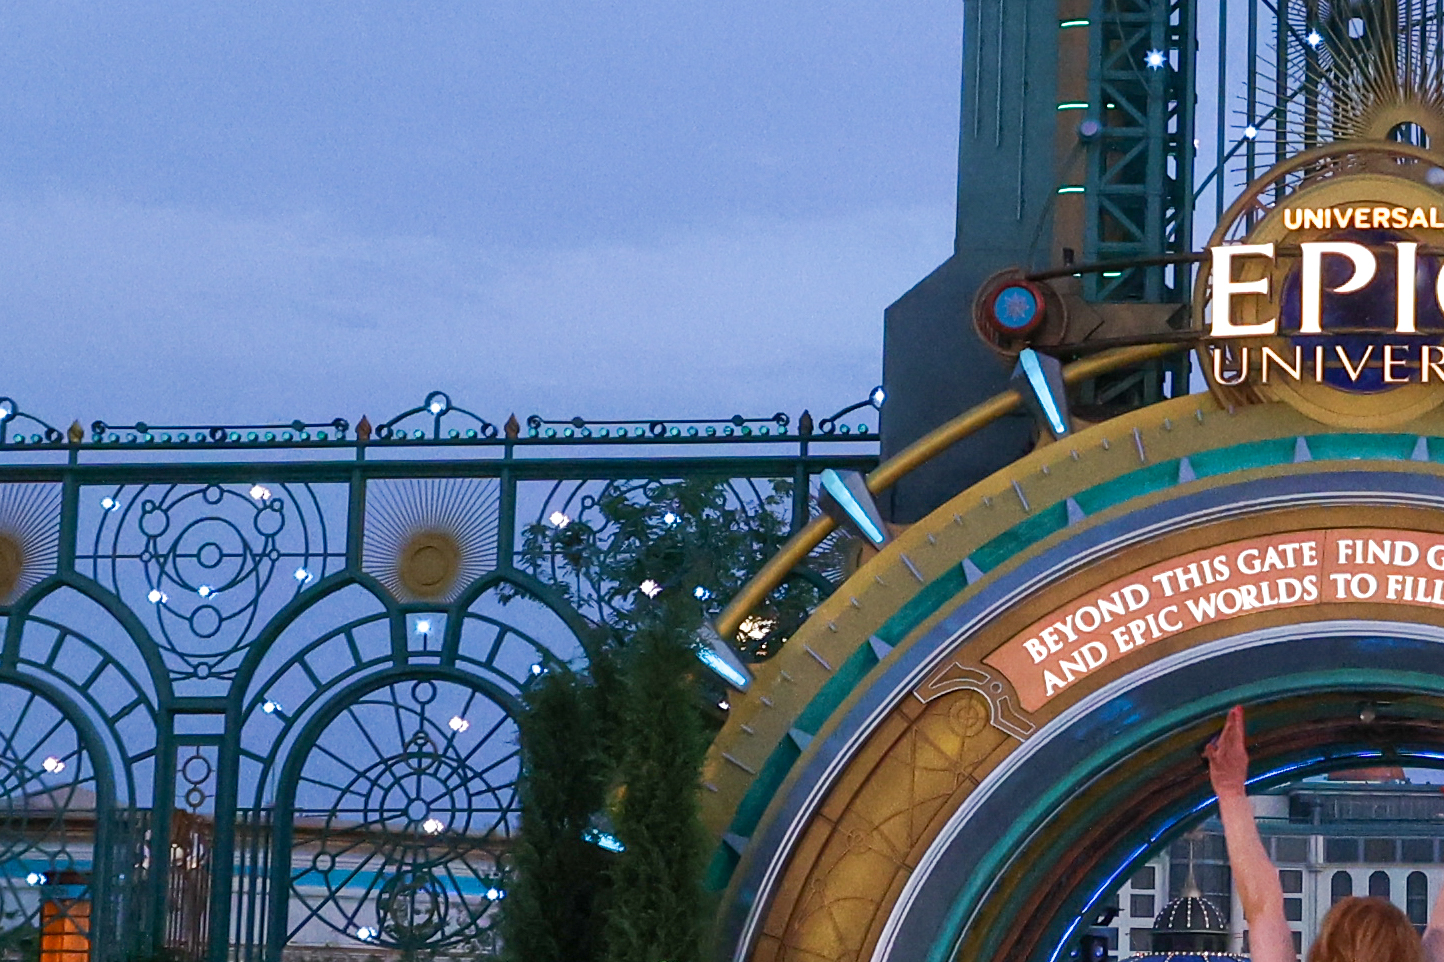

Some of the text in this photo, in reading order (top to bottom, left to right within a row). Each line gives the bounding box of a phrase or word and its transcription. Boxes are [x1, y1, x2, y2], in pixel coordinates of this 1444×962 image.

[1023, 583, 1150, 664] BEYOND
[1152, 555, 1230, 597] THIS
[1237, 541, 1318, 574] GATE
[1337, 540, 1419, 566] FIND
[1043, 641, 1108, 697] AND
[1111, 604, 1183, 654] EPIC
[1185, 575, 1319, 623] WORLDS
[1330, 573, 1378, 599] TO
